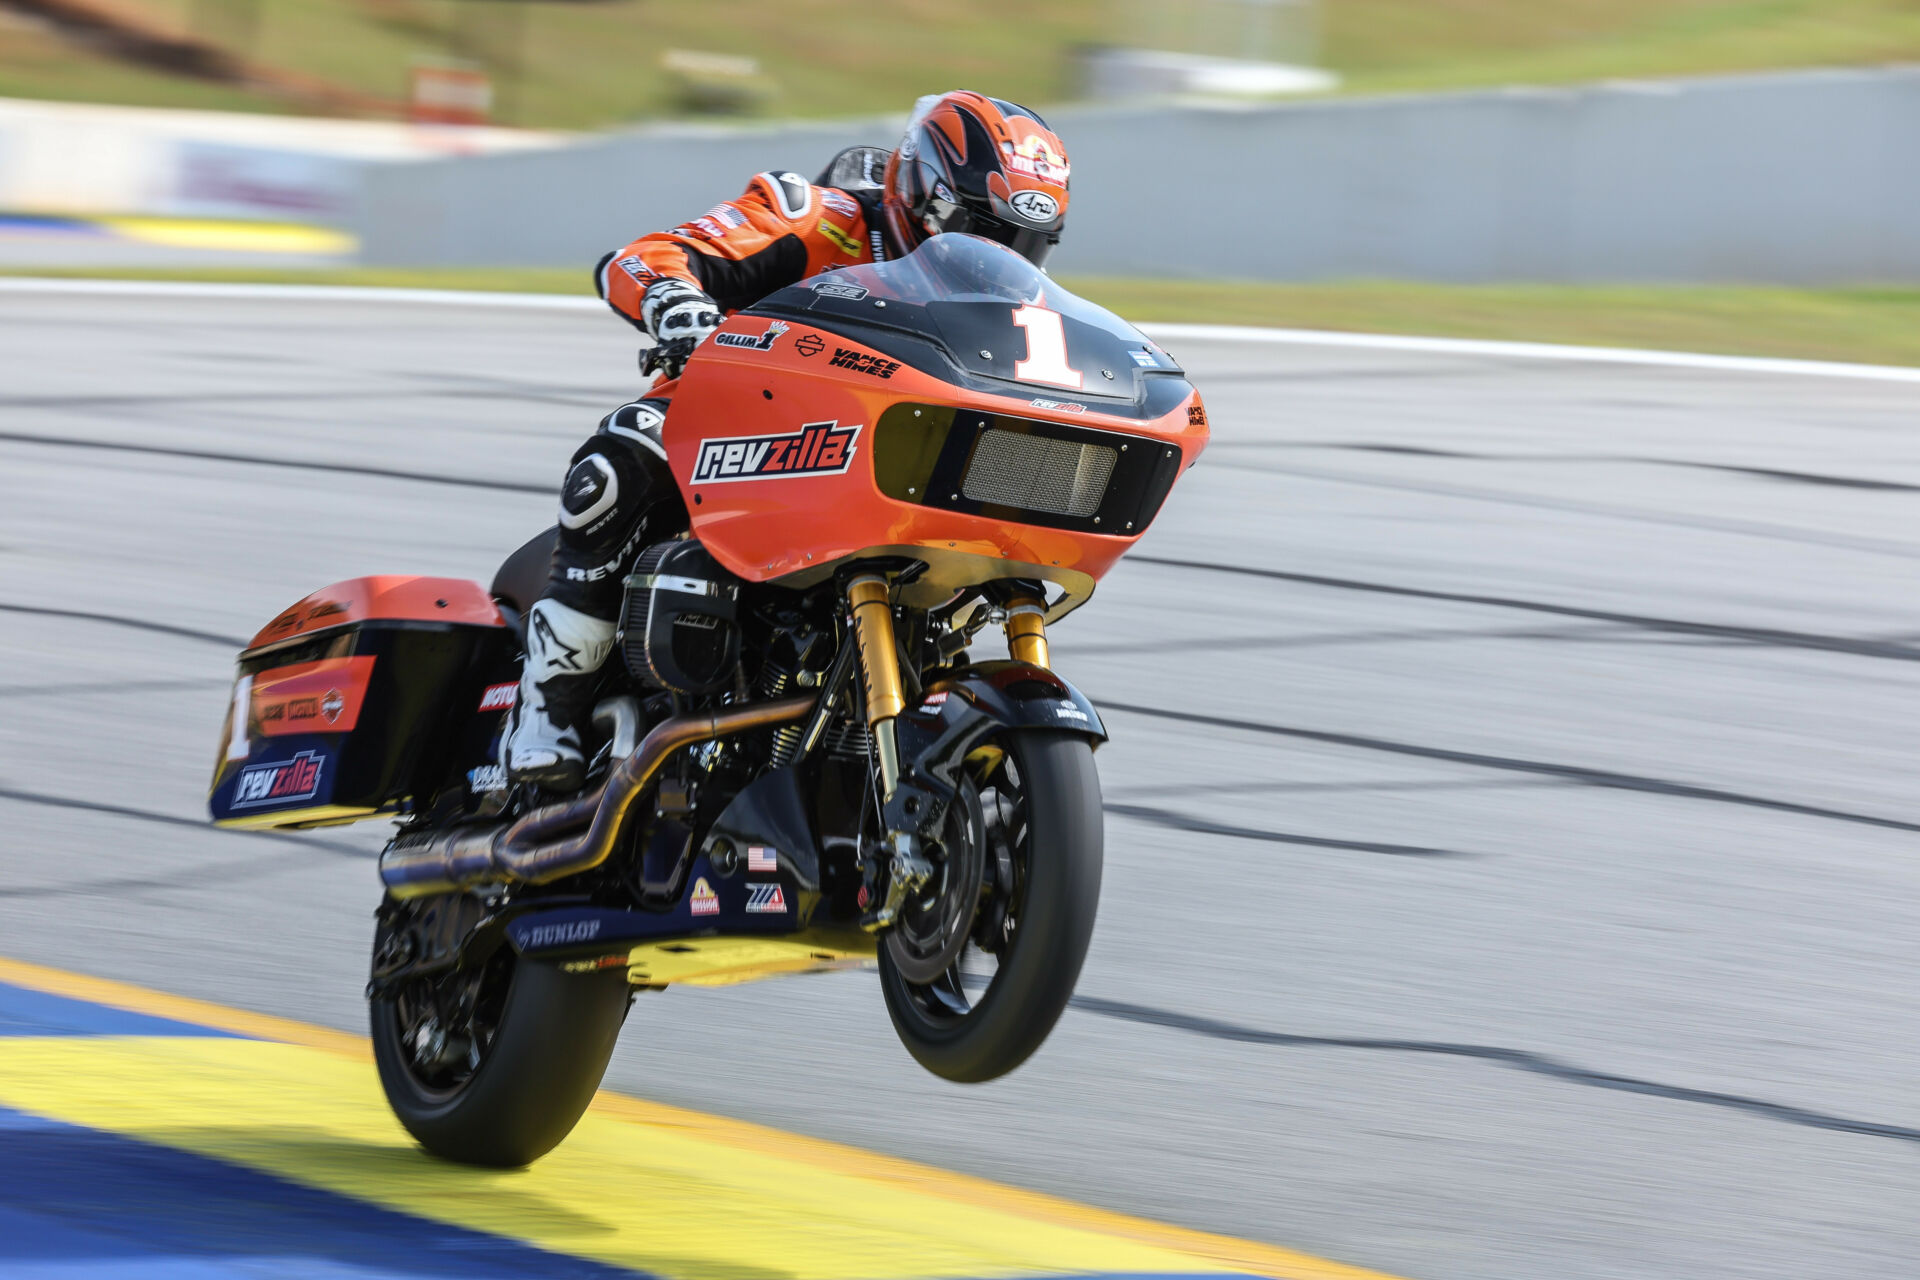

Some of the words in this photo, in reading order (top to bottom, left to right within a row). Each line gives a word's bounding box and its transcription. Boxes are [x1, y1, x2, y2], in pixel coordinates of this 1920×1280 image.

[716, 333, 757, 348] GILLIM
[1011, 304, 1084, 391] 1
[828, 357, 894, 380] HINES
[834, 348, 902, 372] VANCE
[699, 428, 850, 480] revzilla
[480, 684, 520, 708] MOTU
[234, 757, 319, 803] revzilla
[530, 919, 601, 947] DUNLOP
